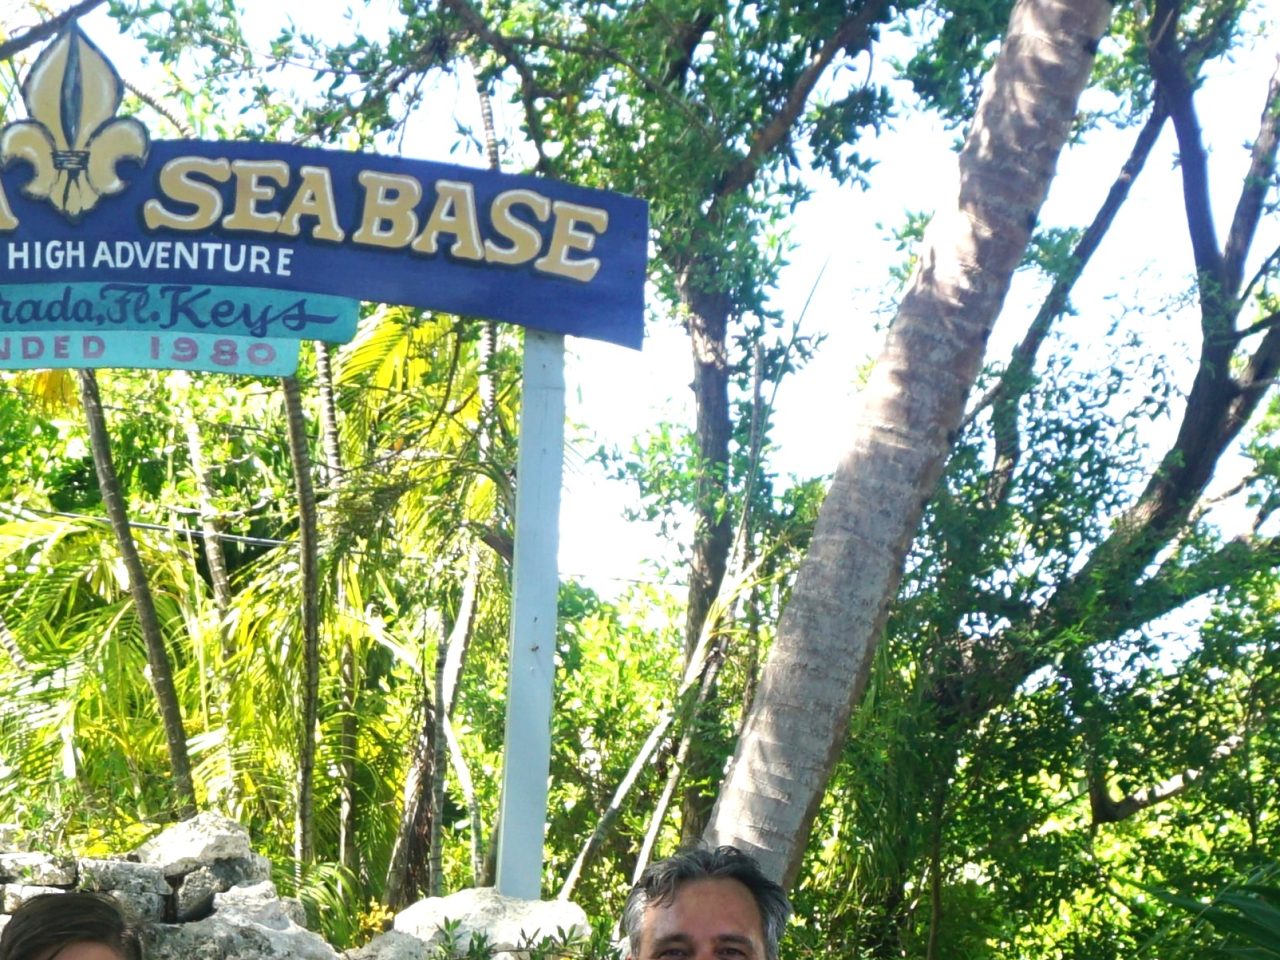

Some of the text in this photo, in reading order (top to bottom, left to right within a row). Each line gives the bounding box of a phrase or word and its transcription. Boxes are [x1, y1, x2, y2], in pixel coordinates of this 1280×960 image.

[142, 155, 345, 242] SEA
[352, 169, 609, 282] BASE
[7, 240, 85, 270] HIGH
[92, 240, 295, 277] ADVENTURE
[160, 285, 339, 338] Keys
[149, 336, 277, 367] 1980
